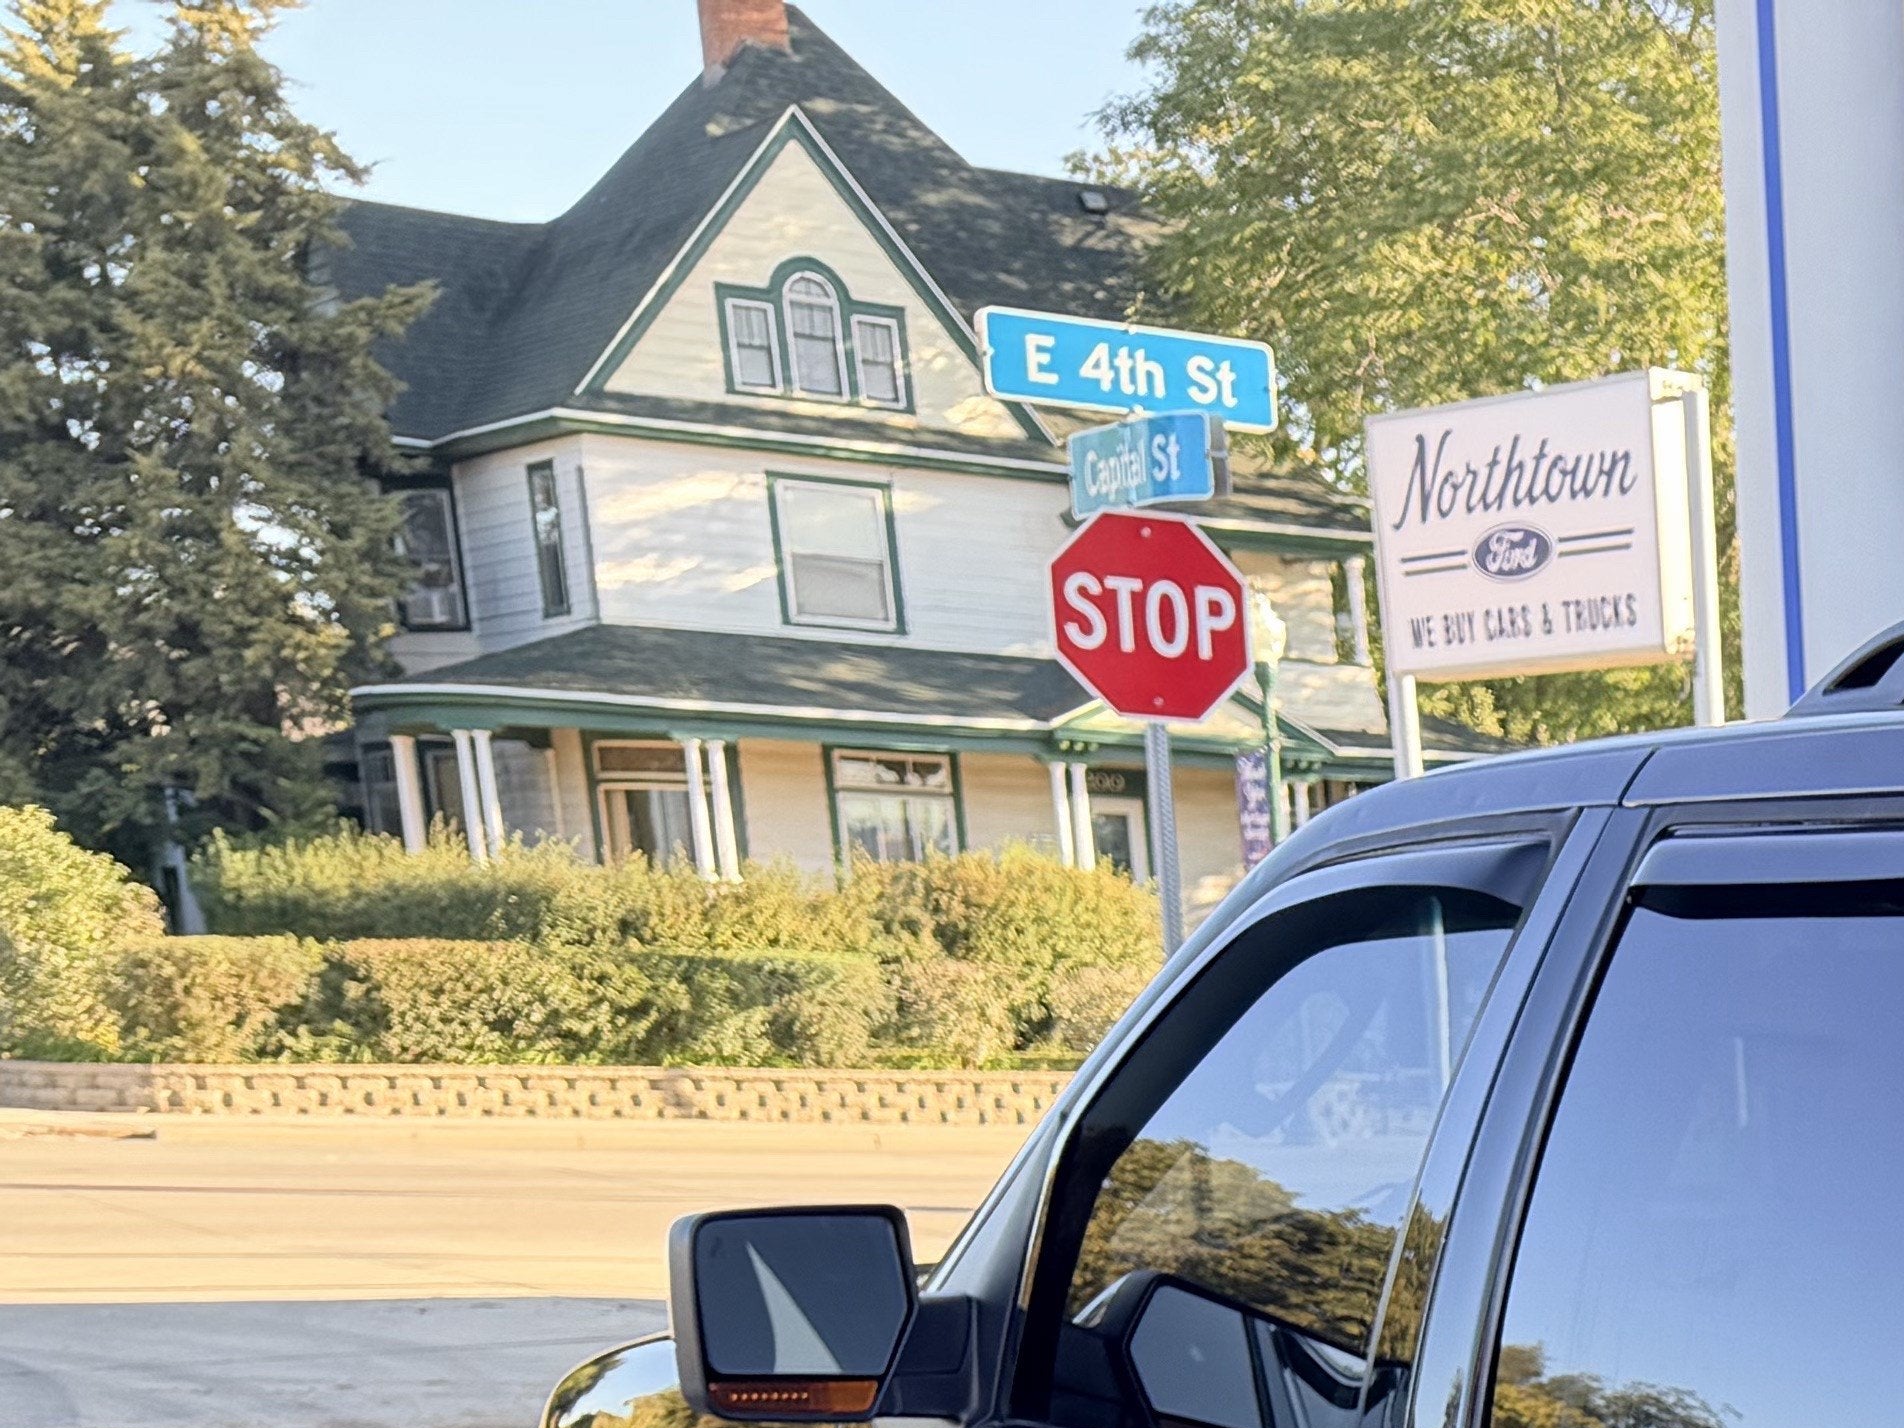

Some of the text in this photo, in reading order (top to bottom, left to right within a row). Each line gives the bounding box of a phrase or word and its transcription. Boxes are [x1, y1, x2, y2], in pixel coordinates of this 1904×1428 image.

[1024, 333, 1238, 408] E 4th St
[1083, 433, 1181, 497] Capital St
[1392, 428, 1638, 530] Northtown
[1484, 530, 1539, 573] Ford
[1063, 571, 1236, 660] STOP
[1410, 593, 1638, 648] WE BUY CARS & TRUCKS
